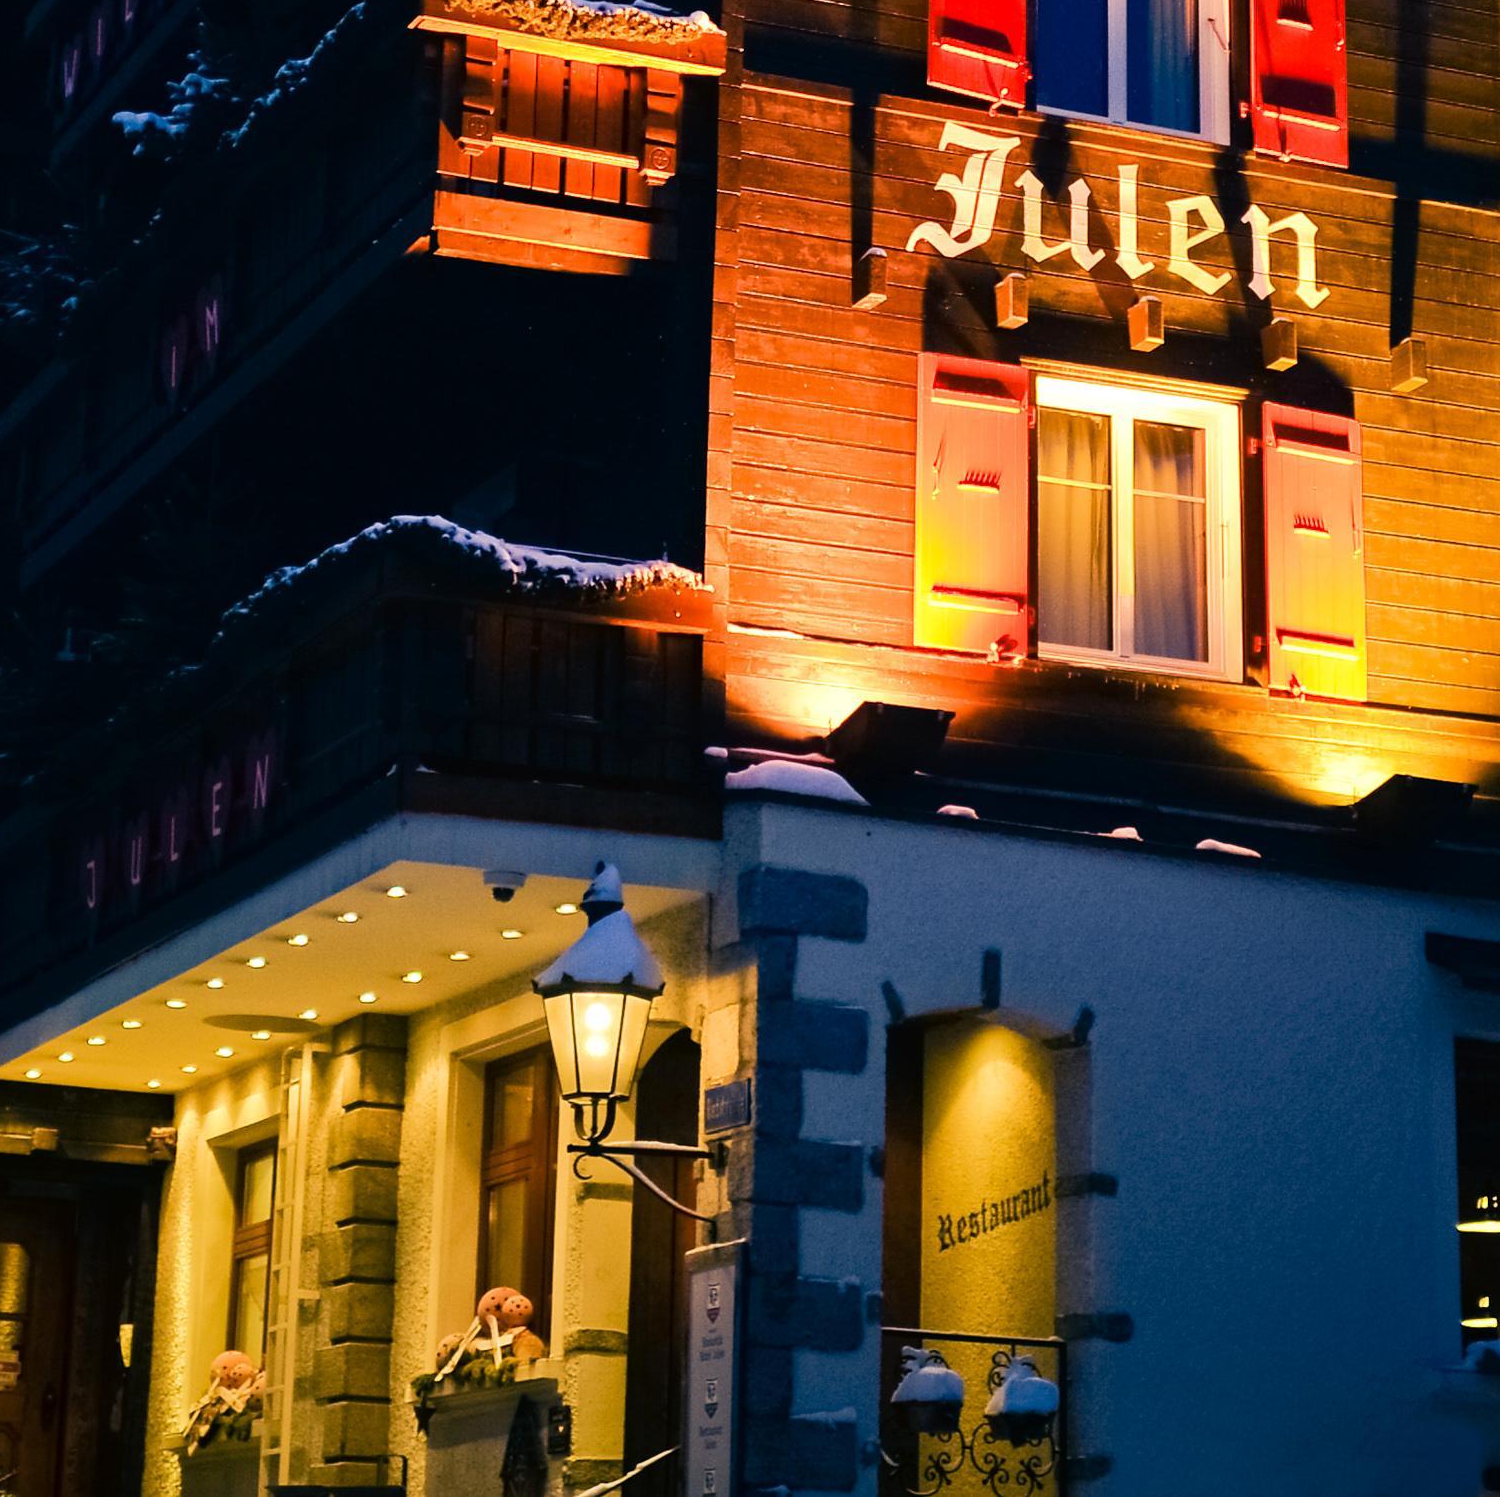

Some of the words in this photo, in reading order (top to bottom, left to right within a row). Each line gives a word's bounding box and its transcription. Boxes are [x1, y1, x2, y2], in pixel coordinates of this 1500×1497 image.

[905, 120, 1331, 310] Julen
[86, 754, 269, 910] JULEN
[938, 1169, 1050, 1253] Restaurant
